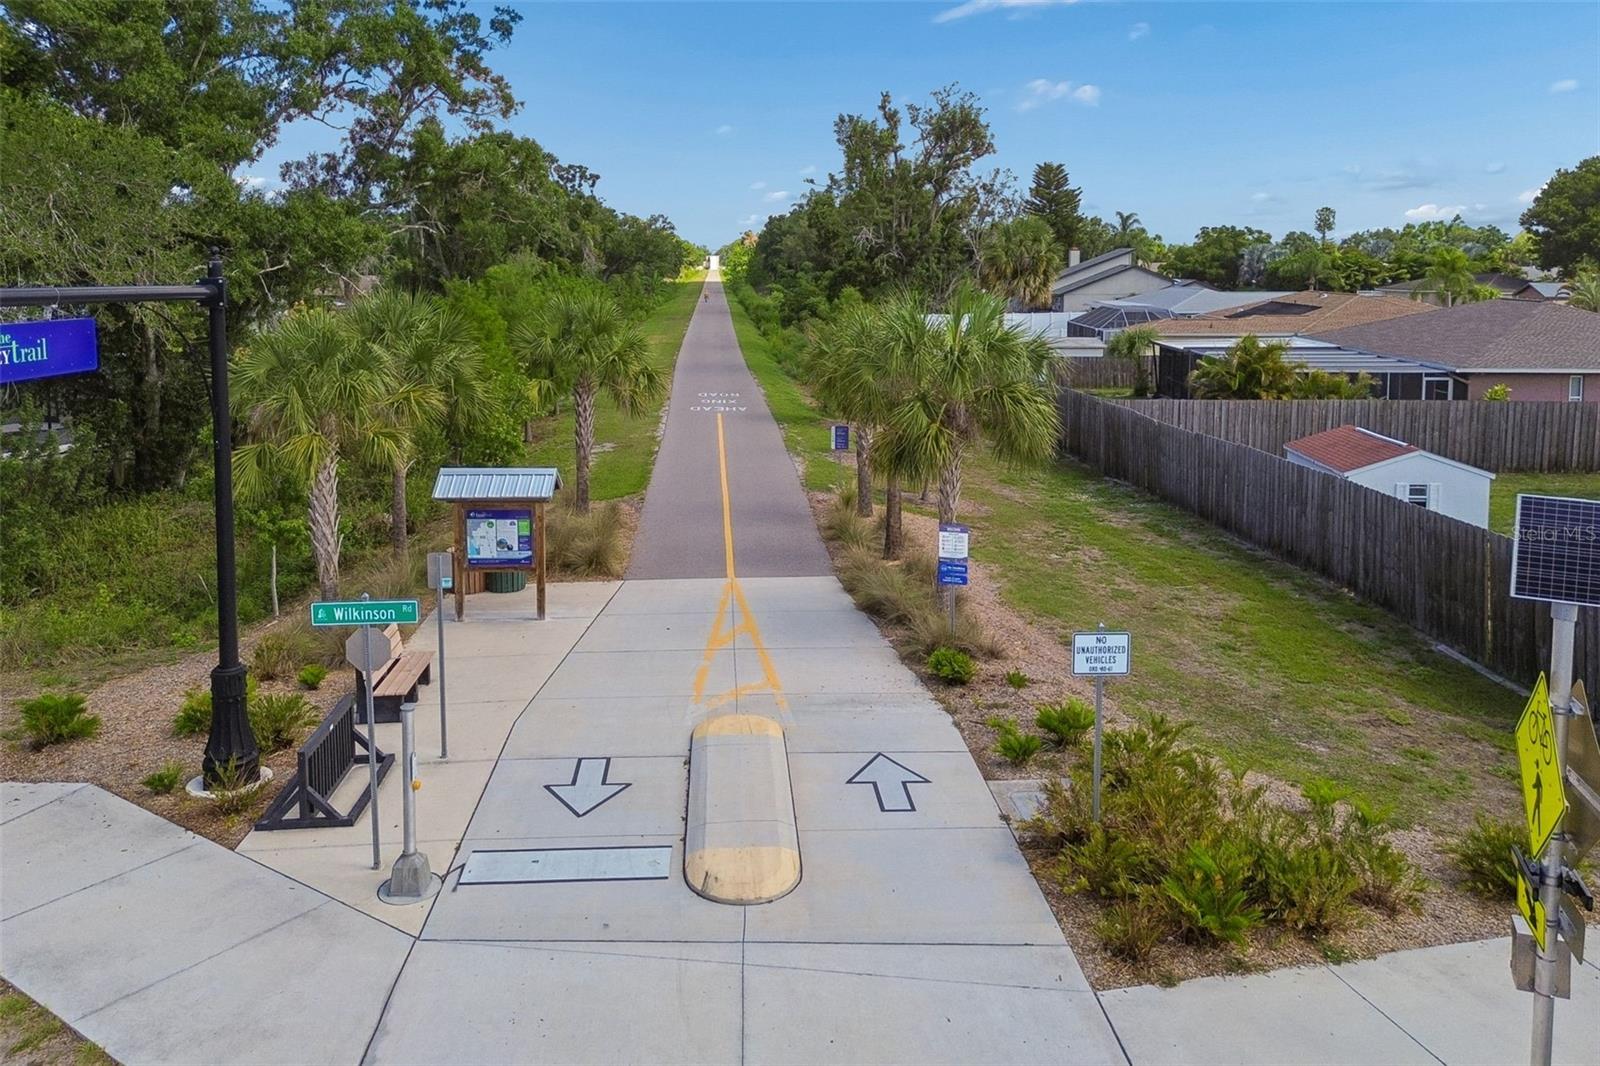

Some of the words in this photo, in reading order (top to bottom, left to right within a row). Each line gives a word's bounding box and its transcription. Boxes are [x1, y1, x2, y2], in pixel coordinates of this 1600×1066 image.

[333, 607, 396, 621] Wilkinson
[402, 605, 412, 613] Rd
[1096, 636, 1107, 644] NO
[1076, 645, 1126, 655] UNAUTHORIZED
[1085, 655, 1117, 665] VEHICLES
